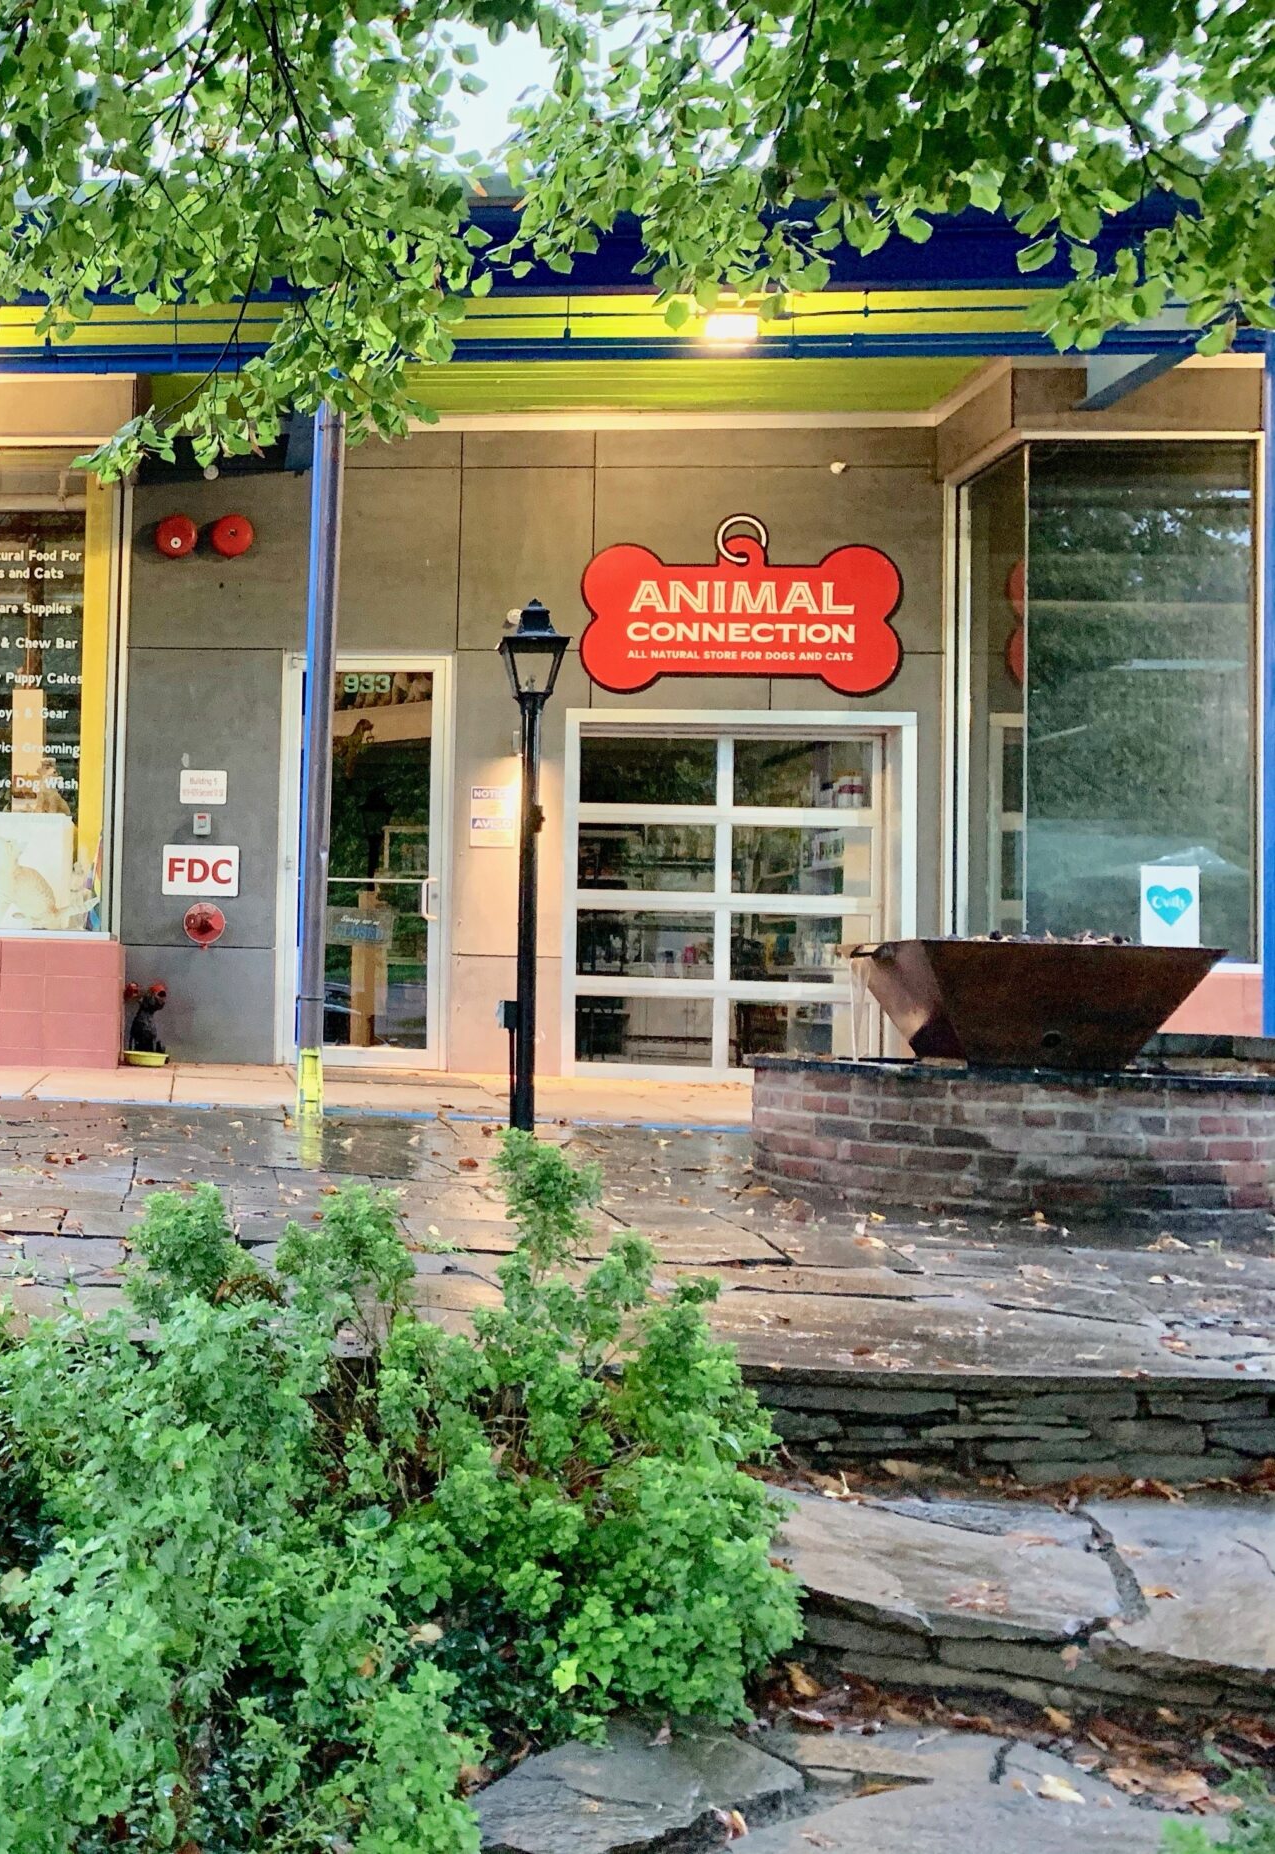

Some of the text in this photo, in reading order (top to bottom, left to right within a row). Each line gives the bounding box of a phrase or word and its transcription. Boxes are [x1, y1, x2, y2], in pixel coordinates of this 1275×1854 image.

[28, 550, 58, 562] Food
[61, 551, 82, 562] For
[8, 567, 31, 579] and
[34, 567, 64, 579] Cats
[628, 580, 855, 615] ANIMAL
[23, 602, 73, 617] Supplies
[626, 621, 856, 644] CONNECTION
[0, 637, 10, 649] &
[15, 637, 51, 649] Chew
[56, 638, 78, 649] Bar
[627, 649, 854, 661] ALL NATURAL STORE FOR DOGS AND CATS
[5, 672, 42, 687] Puppy
[46, 672, 83, 685] Cakes
[343, 673, 391, 693] 933
[41, 707, 69, 719] Gear
[16, 777, 41, 792] Dog
[44, 778, 79, 790] Wash
[168, 857, 233, 885] FDC
